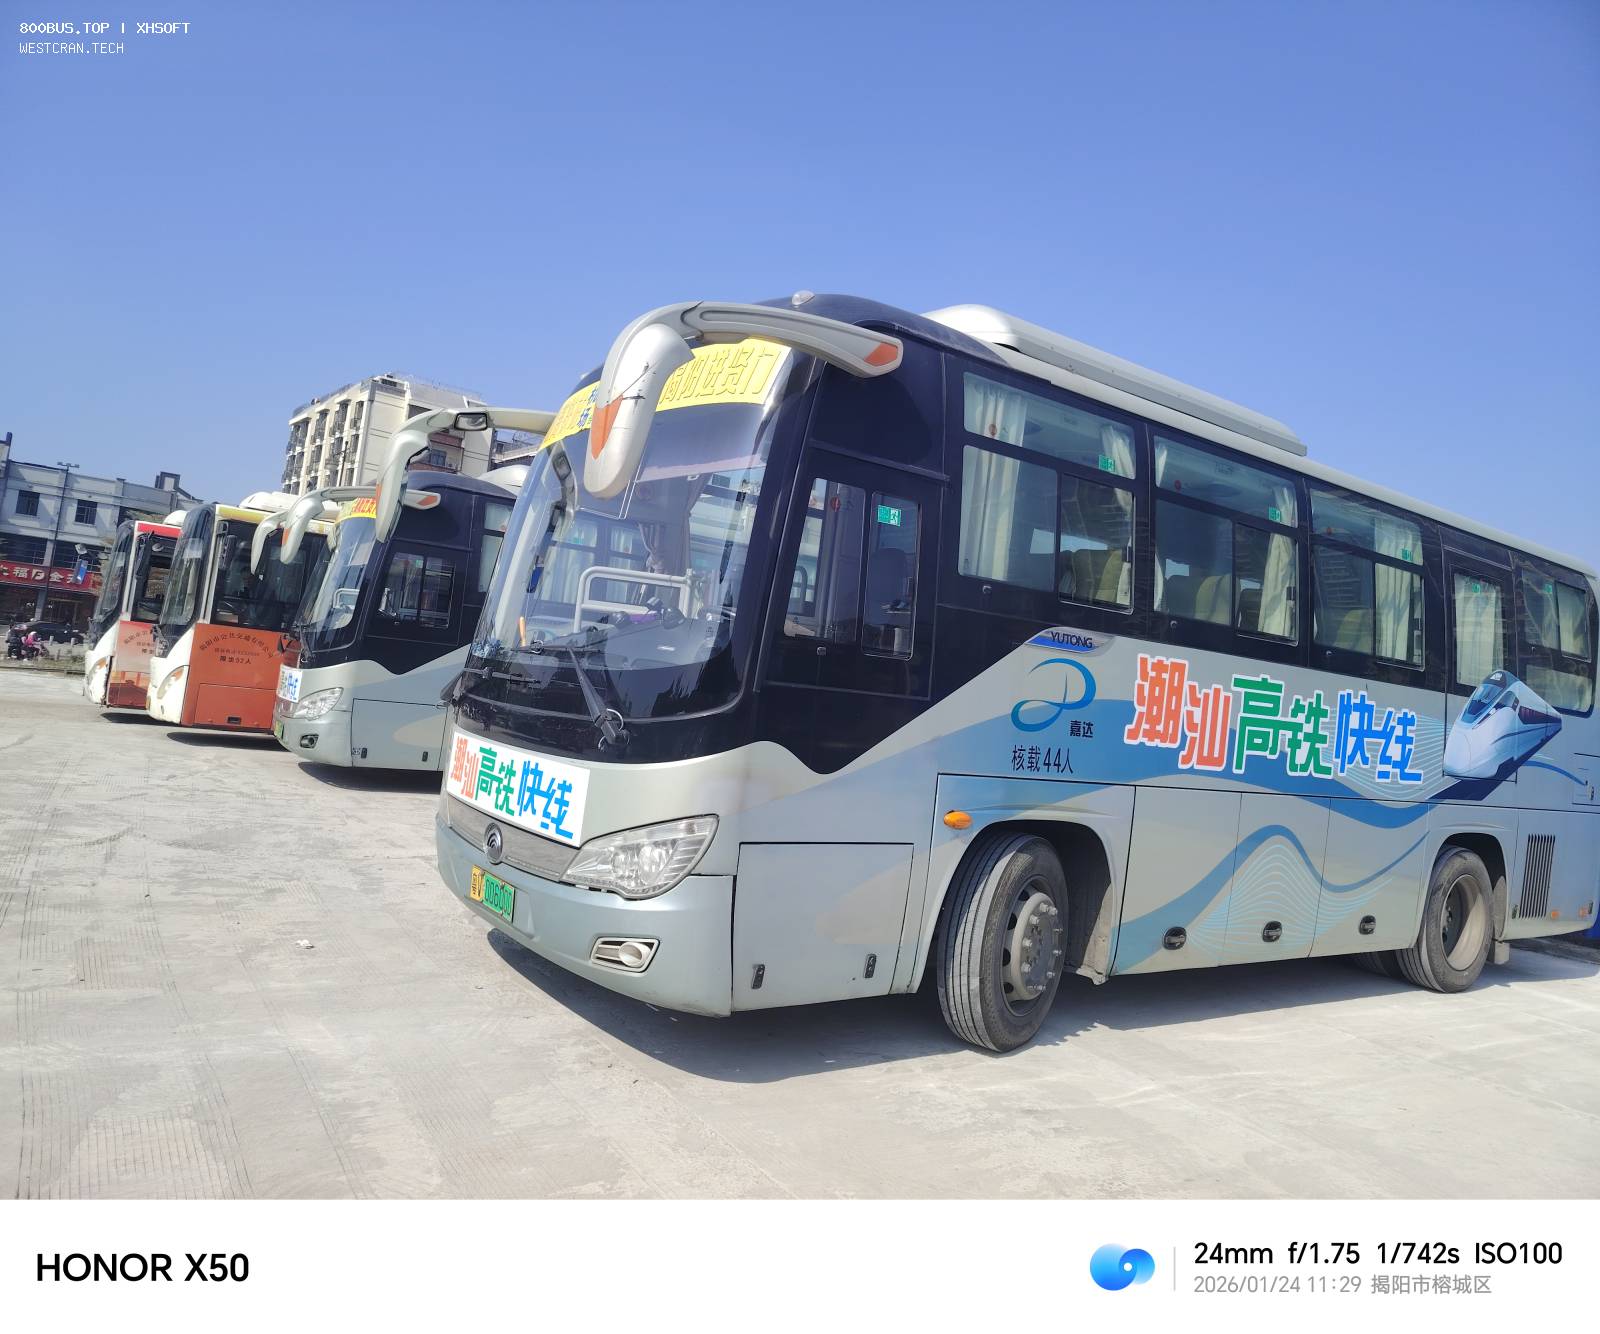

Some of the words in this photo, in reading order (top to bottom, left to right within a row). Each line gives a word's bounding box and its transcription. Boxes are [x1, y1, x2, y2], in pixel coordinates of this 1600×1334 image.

[1050, 631, 1093, 649] YUTONG
[1069, 719, 1094, 739] 嘉达
[1124, 653, 1423, 783] 潮汕高铁快线
[1011, 744, 1074, 774] 核载44人
[450, 735, 574, 840] 潮汕高铁快线
